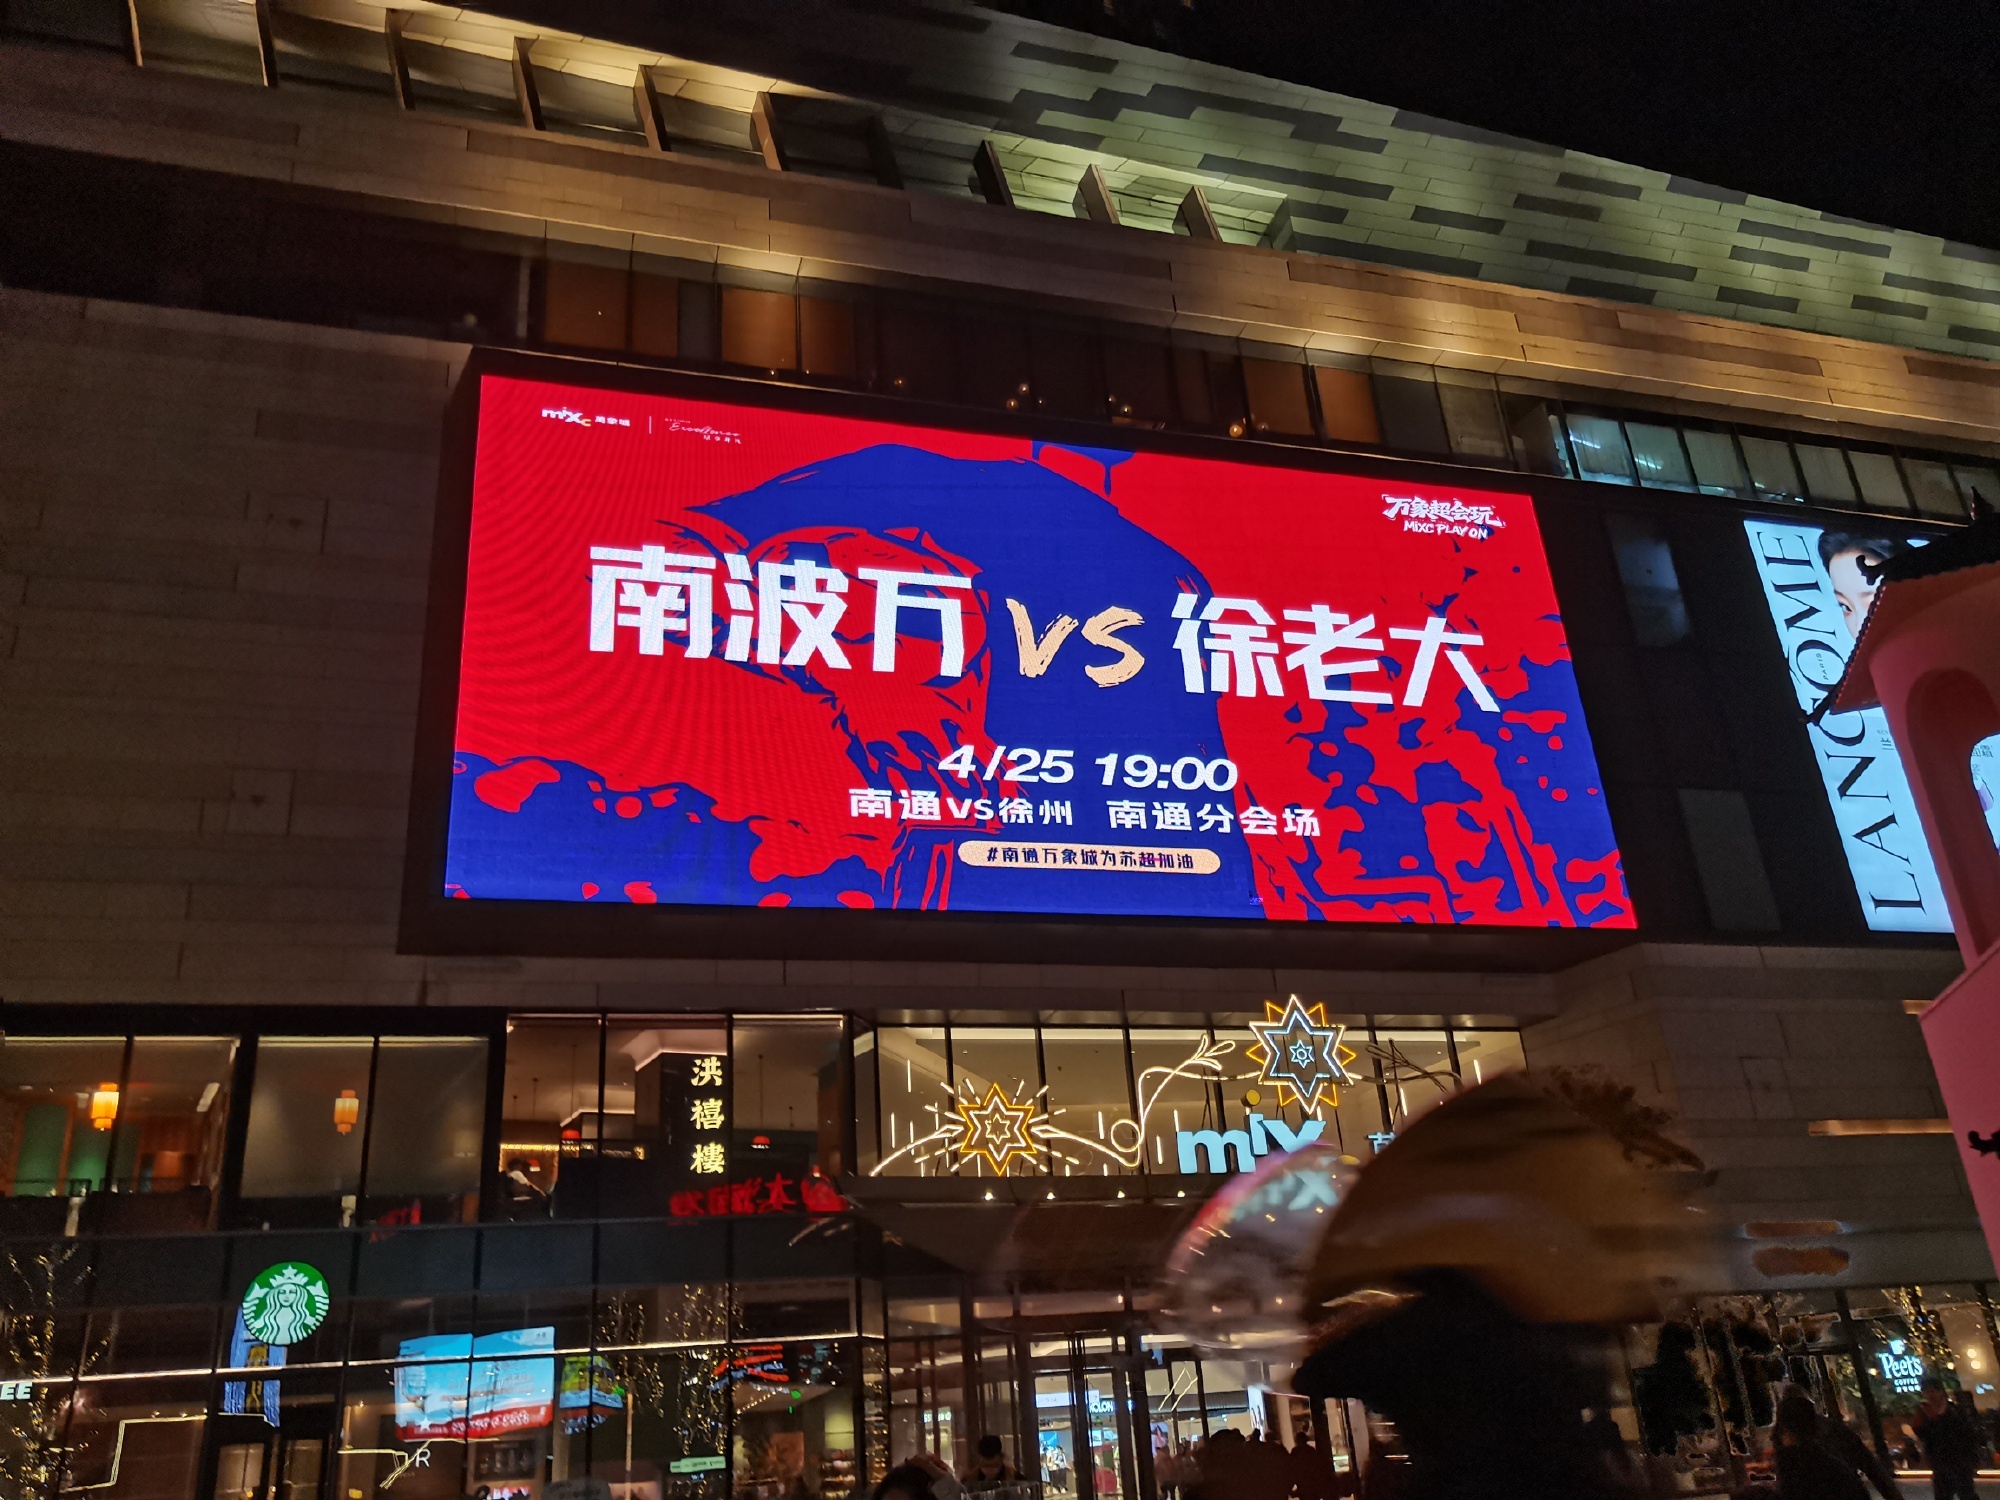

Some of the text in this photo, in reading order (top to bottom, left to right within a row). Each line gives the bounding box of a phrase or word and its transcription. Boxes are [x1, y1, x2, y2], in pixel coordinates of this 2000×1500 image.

[1381, 494, 1505, 528] 万象超会玩
[1437, 523, 1468, 537] PLAY
[1468, 527, 1489, 539] ON
[589, 544, 1501, 713] 南波万 VS 徐老大
[937, 744, 1239, 792] 4/25 19:00
[848, 787, 1321, 837] 南通VS徐州 南通分会场
[986, 846, 1194, 870] #南通万象城为苏超加油
[690, 1056, 727, 1175] 洪禧樓
[1878, 1353, 1923, 1379] Peet's
